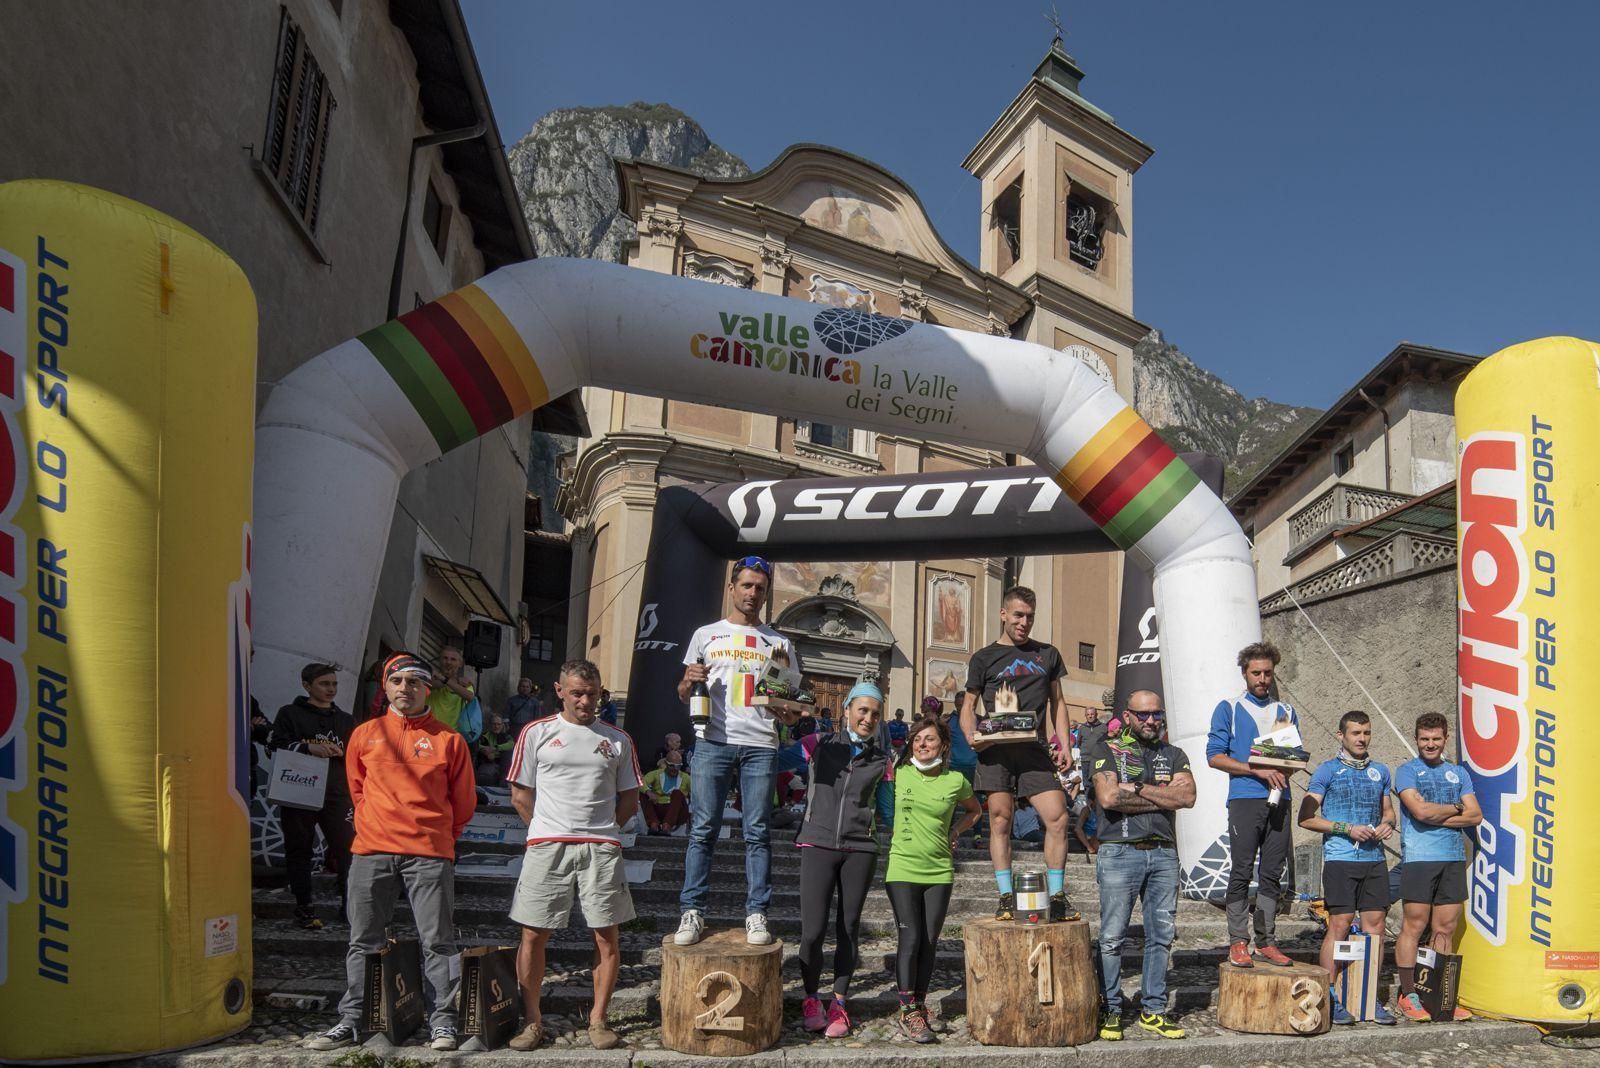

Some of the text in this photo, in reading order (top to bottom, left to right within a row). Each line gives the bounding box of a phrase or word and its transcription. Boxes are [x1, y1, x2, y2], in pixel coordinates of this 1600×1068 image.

[719, 312, 810, 349] valle
[690, 332, 862, 386] camonica
[873, 364, 958, 402] la Valle
[846, 390, 955, 426] dei Segni
[783, 476, 1063, 522] SCOTT
[36, 236, 70, 985] INTEGRATORI PER LO SPORT
[710, 648, 767, 662] www.pegaru
[1117, 651, 1161, 667] SCO
[1530, 414, 1556, 948] INTEGRATORI PER LO SPORT
[1471, 820, 1498, 930] PRO
[1028, 941, 1054, 1004] 1
[490, 998, 513, 1013] SCOTT
[695, 970, 745, 1031] 2
[1288, 979, 1326, 1033] 3
